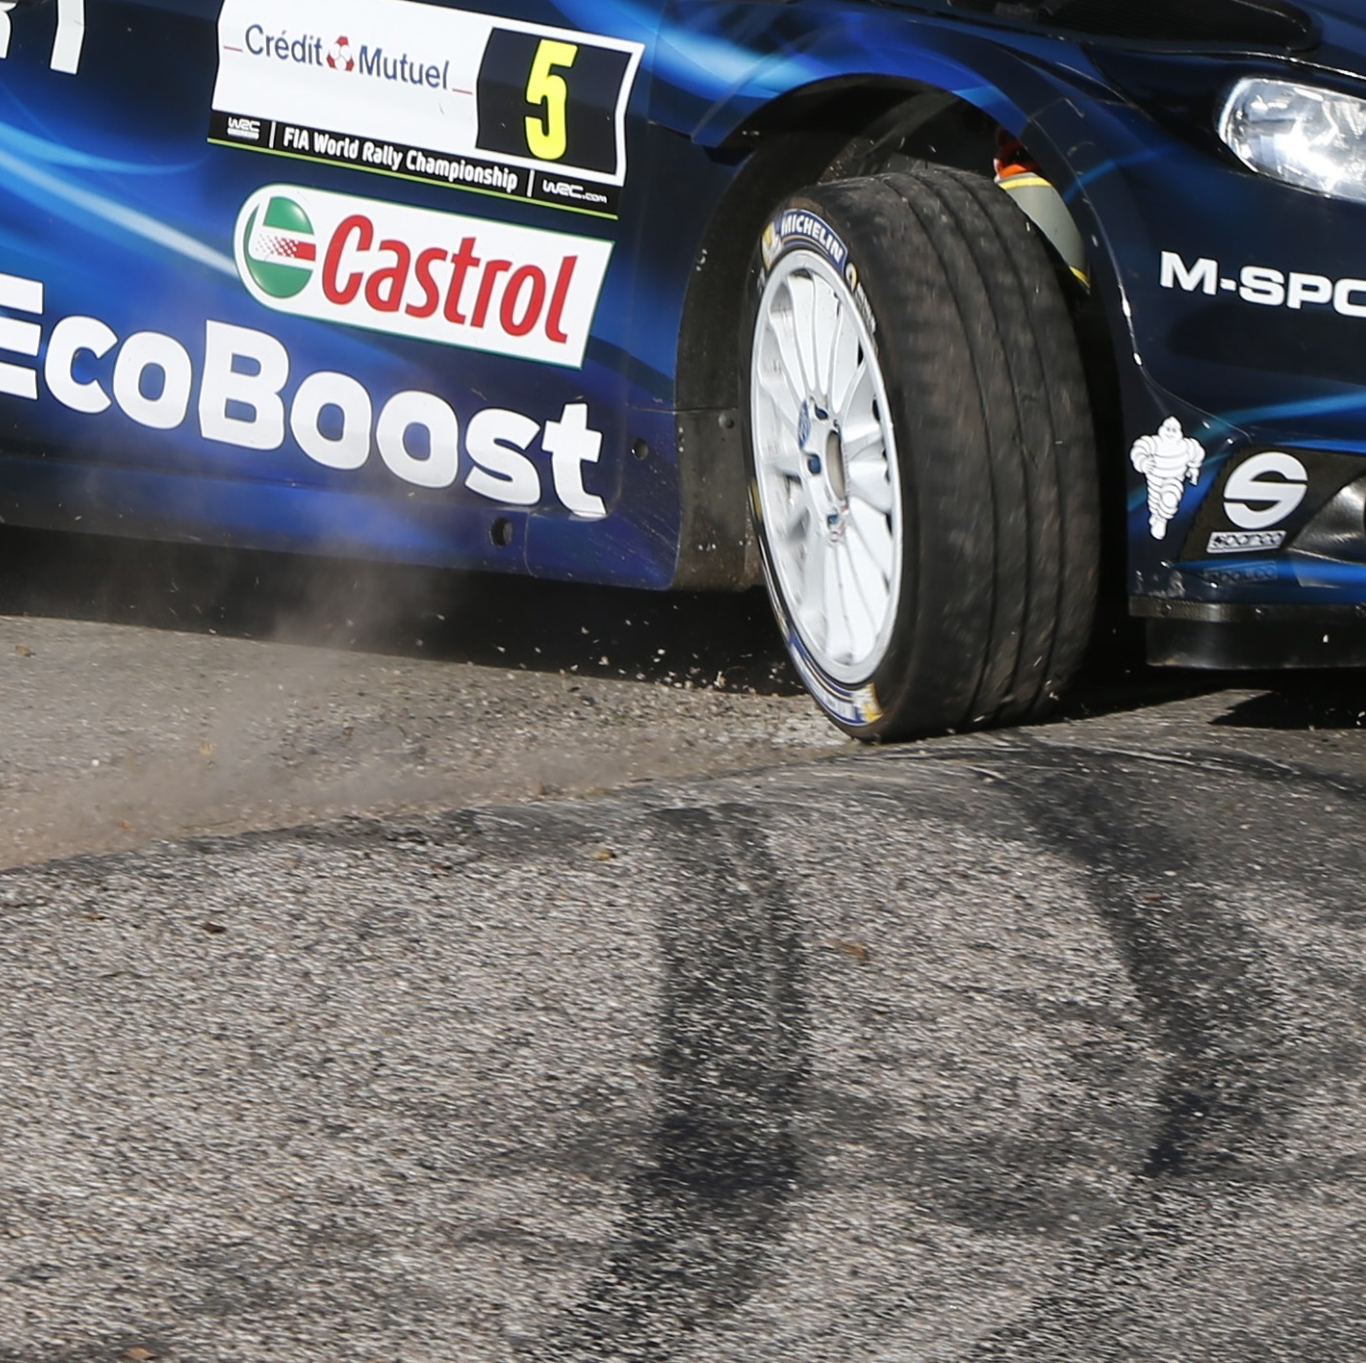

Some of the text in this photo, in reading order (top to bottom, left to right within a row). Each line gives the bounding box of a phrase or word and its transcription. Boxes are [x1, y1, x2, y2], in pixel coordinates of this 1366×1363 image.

[245, 24, 450, 90] Crédit Mutuel
[227, 117, 261, 133] WRC
[524, 38, 579, 160] 5
[283, 126, 310, 152] FIA
[313, 131, 359, 160] World
[362, 140, 403, 171] Rally
[405, 149, 519, 194] Championship
[780, 214, 844, 264] MICHELIN
[321, 214, 578, 345] Castrol
